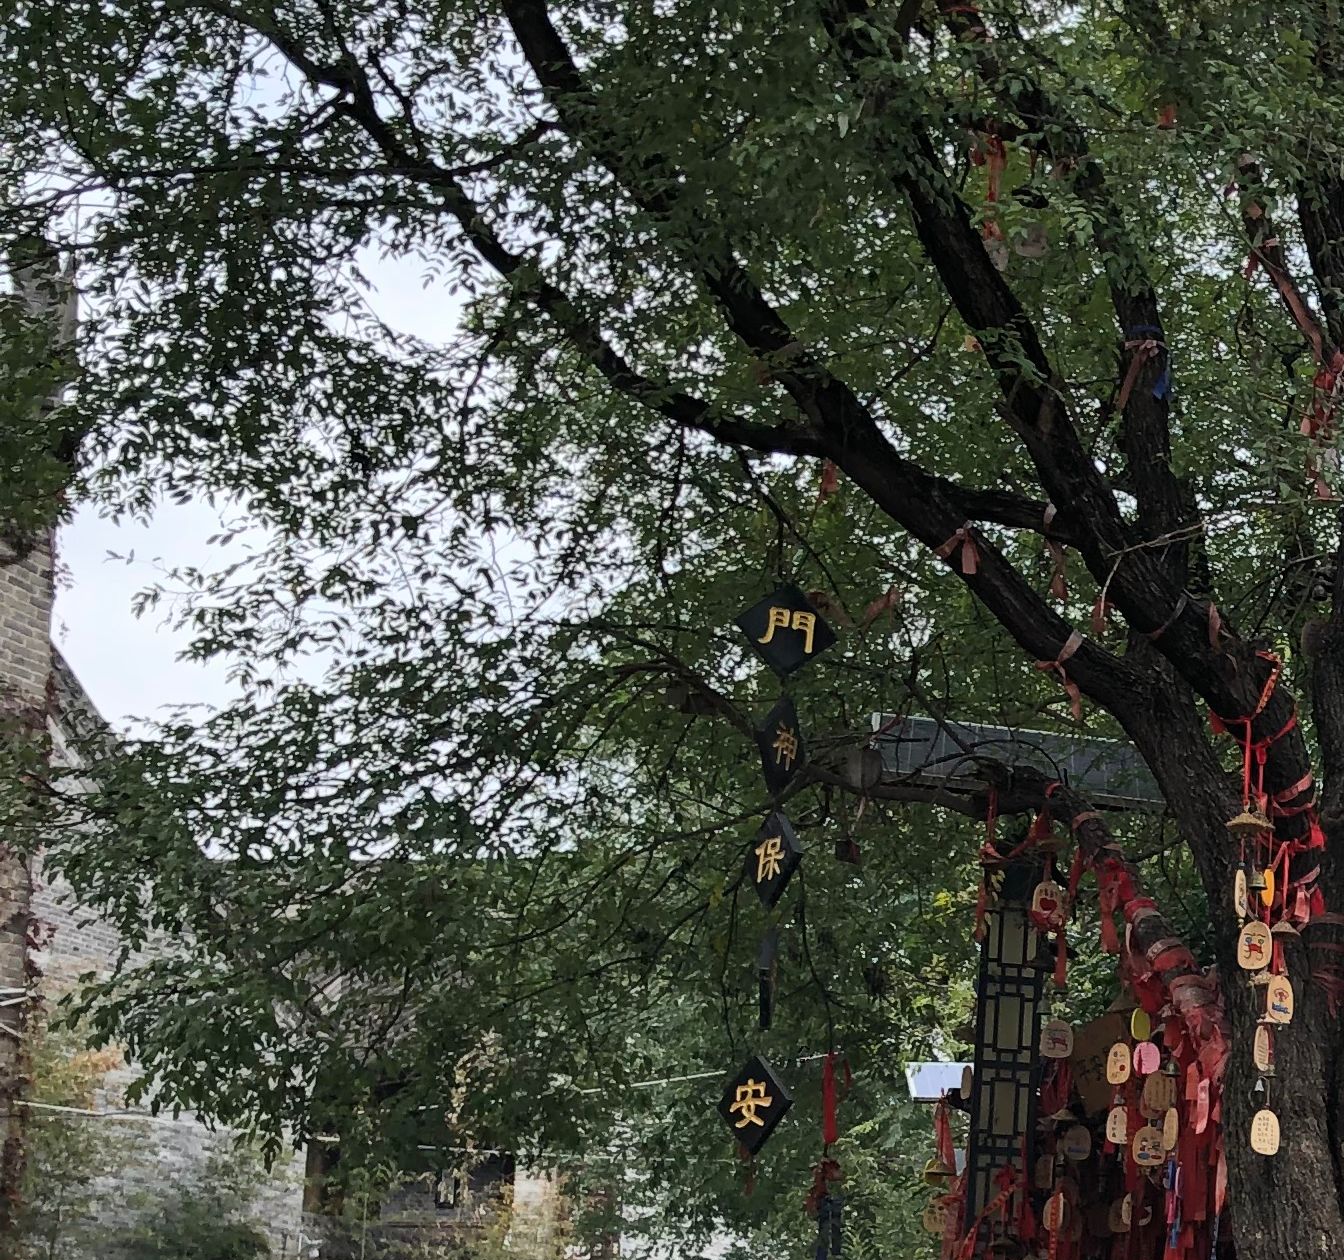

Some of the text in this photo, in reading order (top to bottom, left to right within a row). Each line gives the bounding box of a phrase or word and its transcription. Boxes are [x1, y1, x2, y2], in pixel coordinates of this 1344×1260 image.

[757, 606, 816, 654] 門
[756, 836, 785, 882] 保
[730, 1079, 772, 1128] 安
